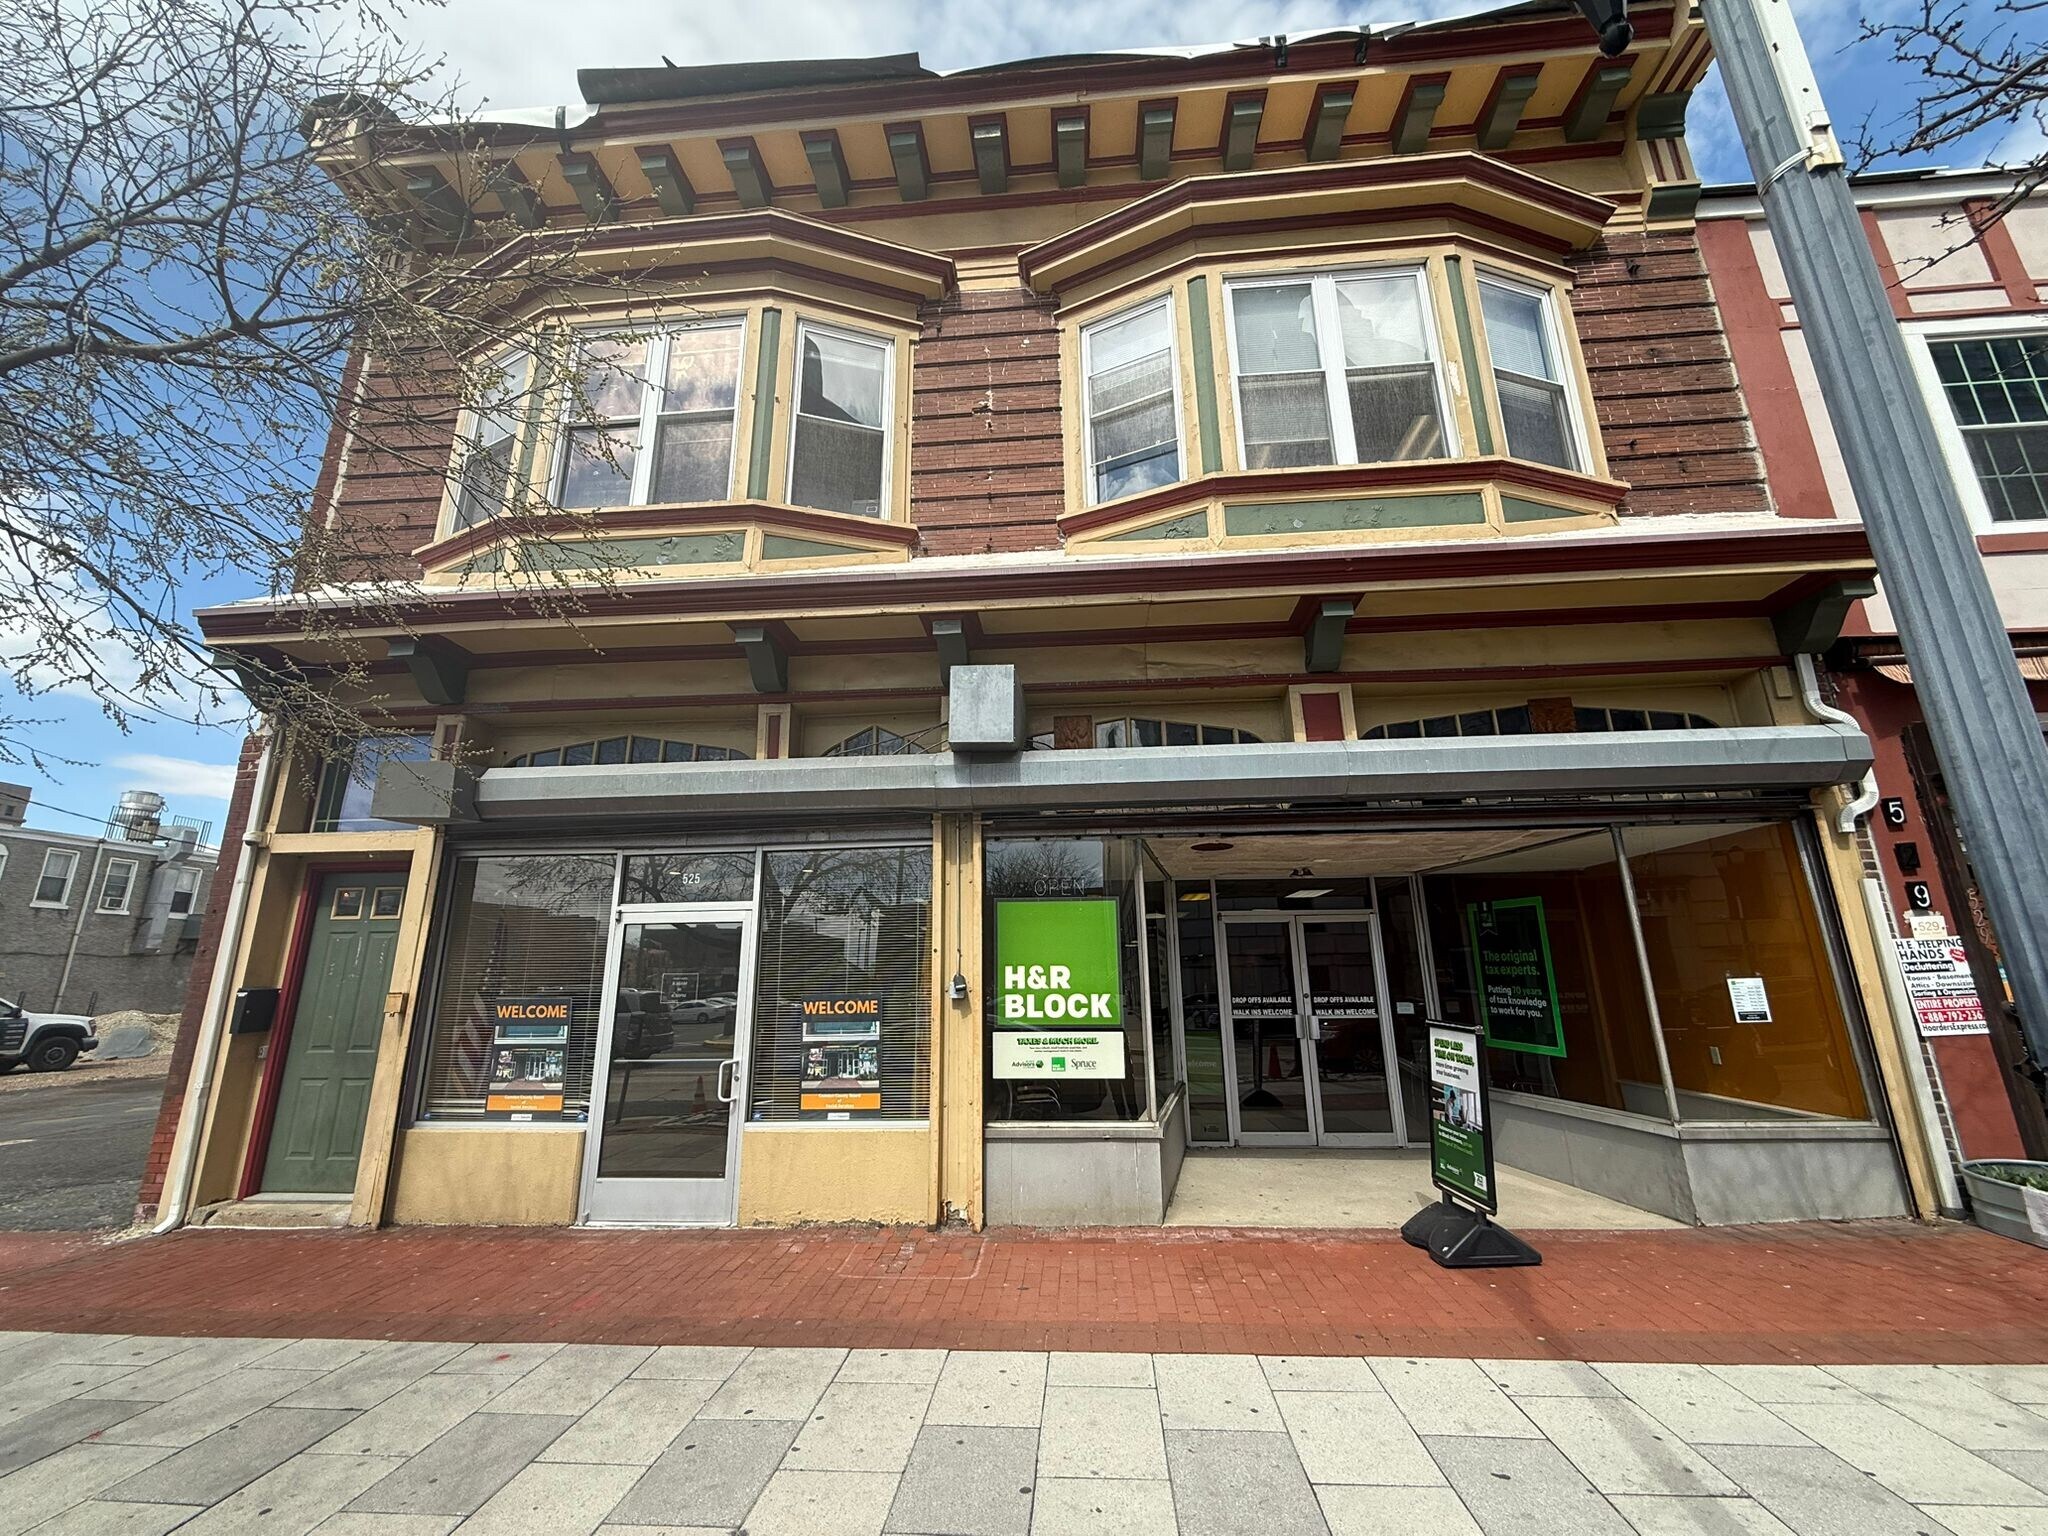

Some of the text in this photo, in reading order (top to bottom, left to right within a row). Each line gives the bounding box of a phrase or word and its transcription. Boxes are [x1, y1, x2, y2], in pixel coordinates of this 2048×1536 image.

[1889, 801, 1905, 823] 5
[1914, 885, 1931, 907] 9
[682, 873, 701, 884] 525
[1034, 877, 1086, 896] OPEN
[1918, 921, 1940, 932] 529
[1483, 949, 1538, 964] The original
[1899, 949, 1945, 961] HANDS
[1485, 965, 1540, 977] tax experts.
[1902, 962, 1954, 972] Decluttering
[1004, 965, 1071, 990] H&R
[1487, 984, 1512, 996] Putting
[1522, 986, 1542, 996] years
[803, 1000, 879, 1014] WELCOME
[1004, 993, 1113, 1019] BLOCK
[1489, 996, 1547, 1009] of tax knowledge
[1915, 998, 1943, 1010] ENTIRE
[497, 1005, 568, 1019] WELCOME
[1490, 1006, 1543, 1018] to work for you.
[1919, 1010, 1986, 1023] 1-888-792-236
[1016, 1037, 1041, 1046] TAXES
[1041, 1037, 1049, 1045] &
[1048, 1037, 1073, 1045] MUCH
[1011, 1060, 1036, 1068] Advisors
[1071, 1058, 1097, 1071] Spruce
